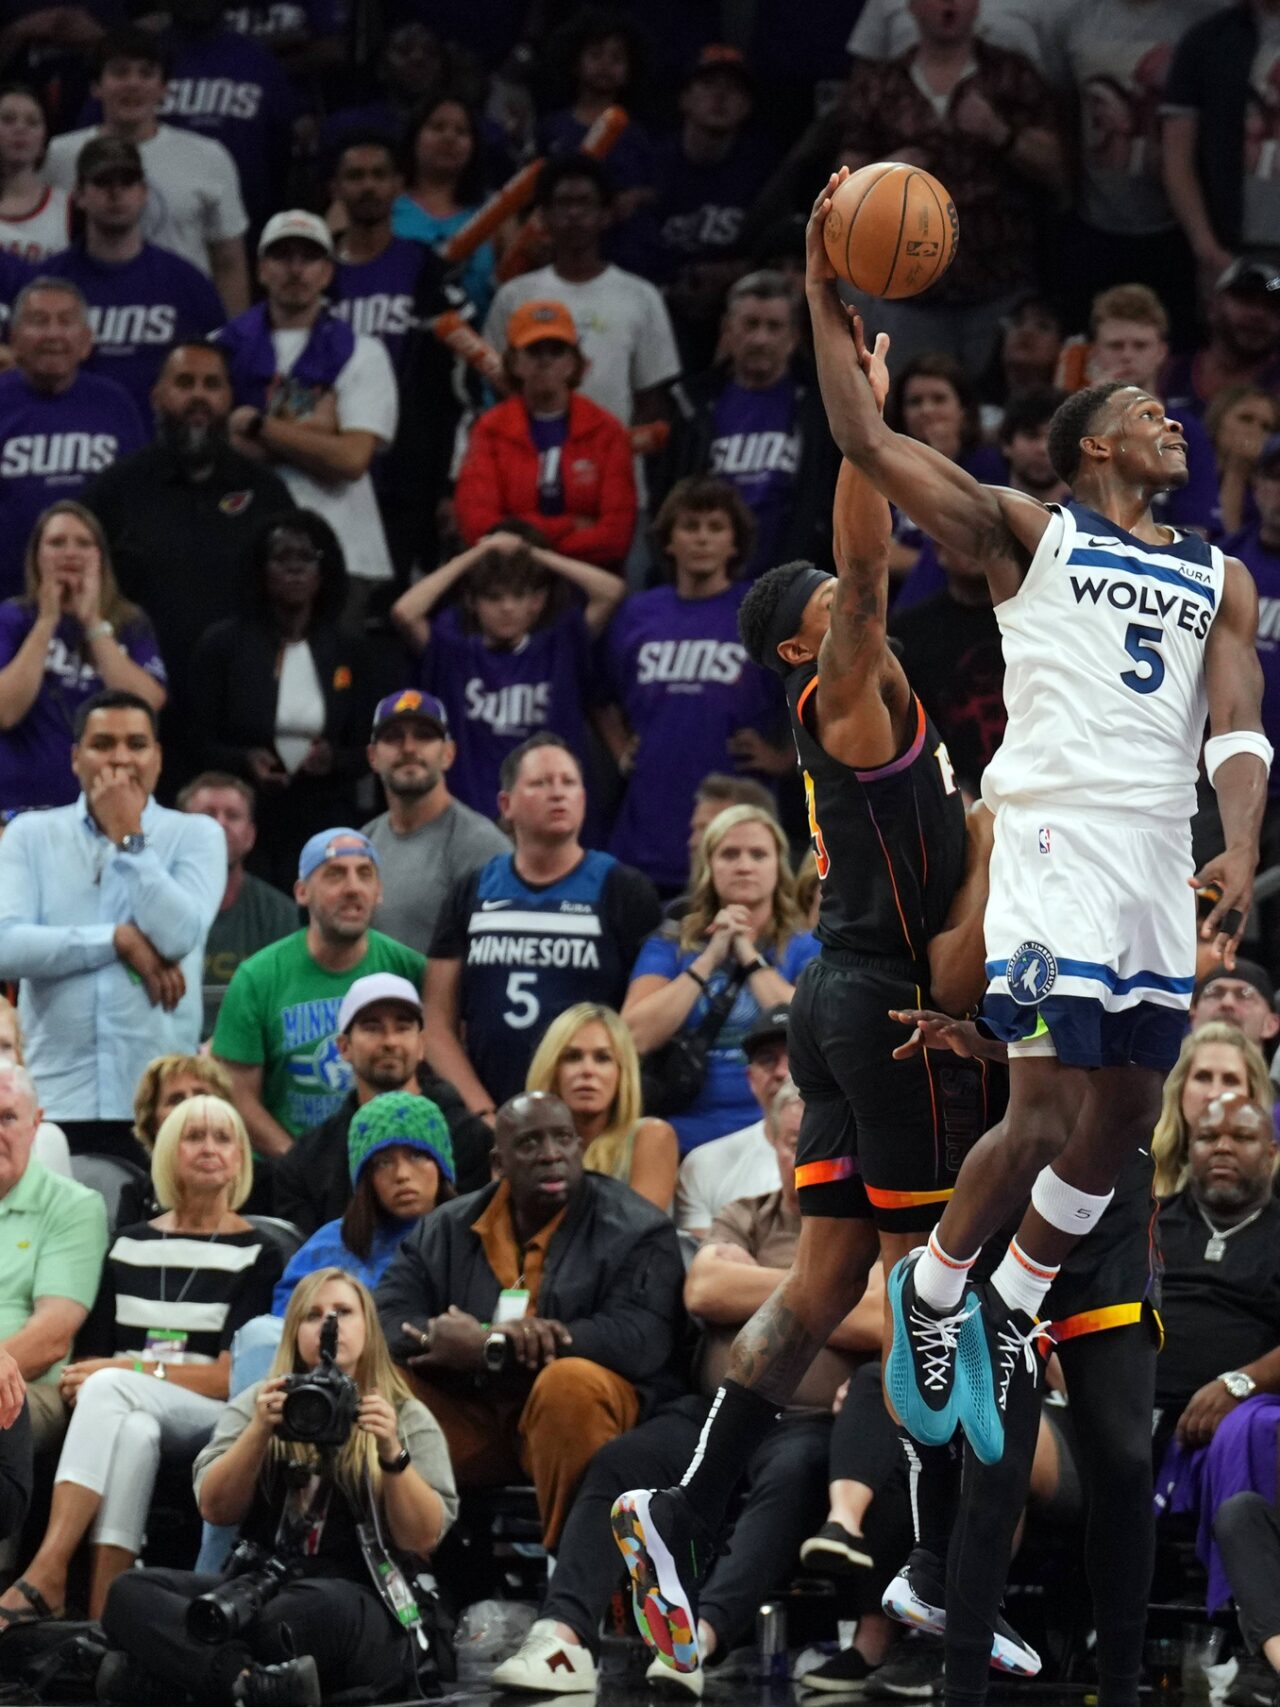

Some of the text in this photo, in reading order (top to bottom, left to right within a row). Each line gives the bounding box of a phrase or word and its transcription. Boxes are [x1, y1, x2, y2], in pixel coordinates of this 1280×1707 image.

[1070, 576, 1212, 640] WOLVES
[1120, 622, 1165, 694] 5
[467, 935, 600, 971] MINNESOTA
[503, 971, 540, 1030] 5
[1075, 1208, 1091, 1219] 5
